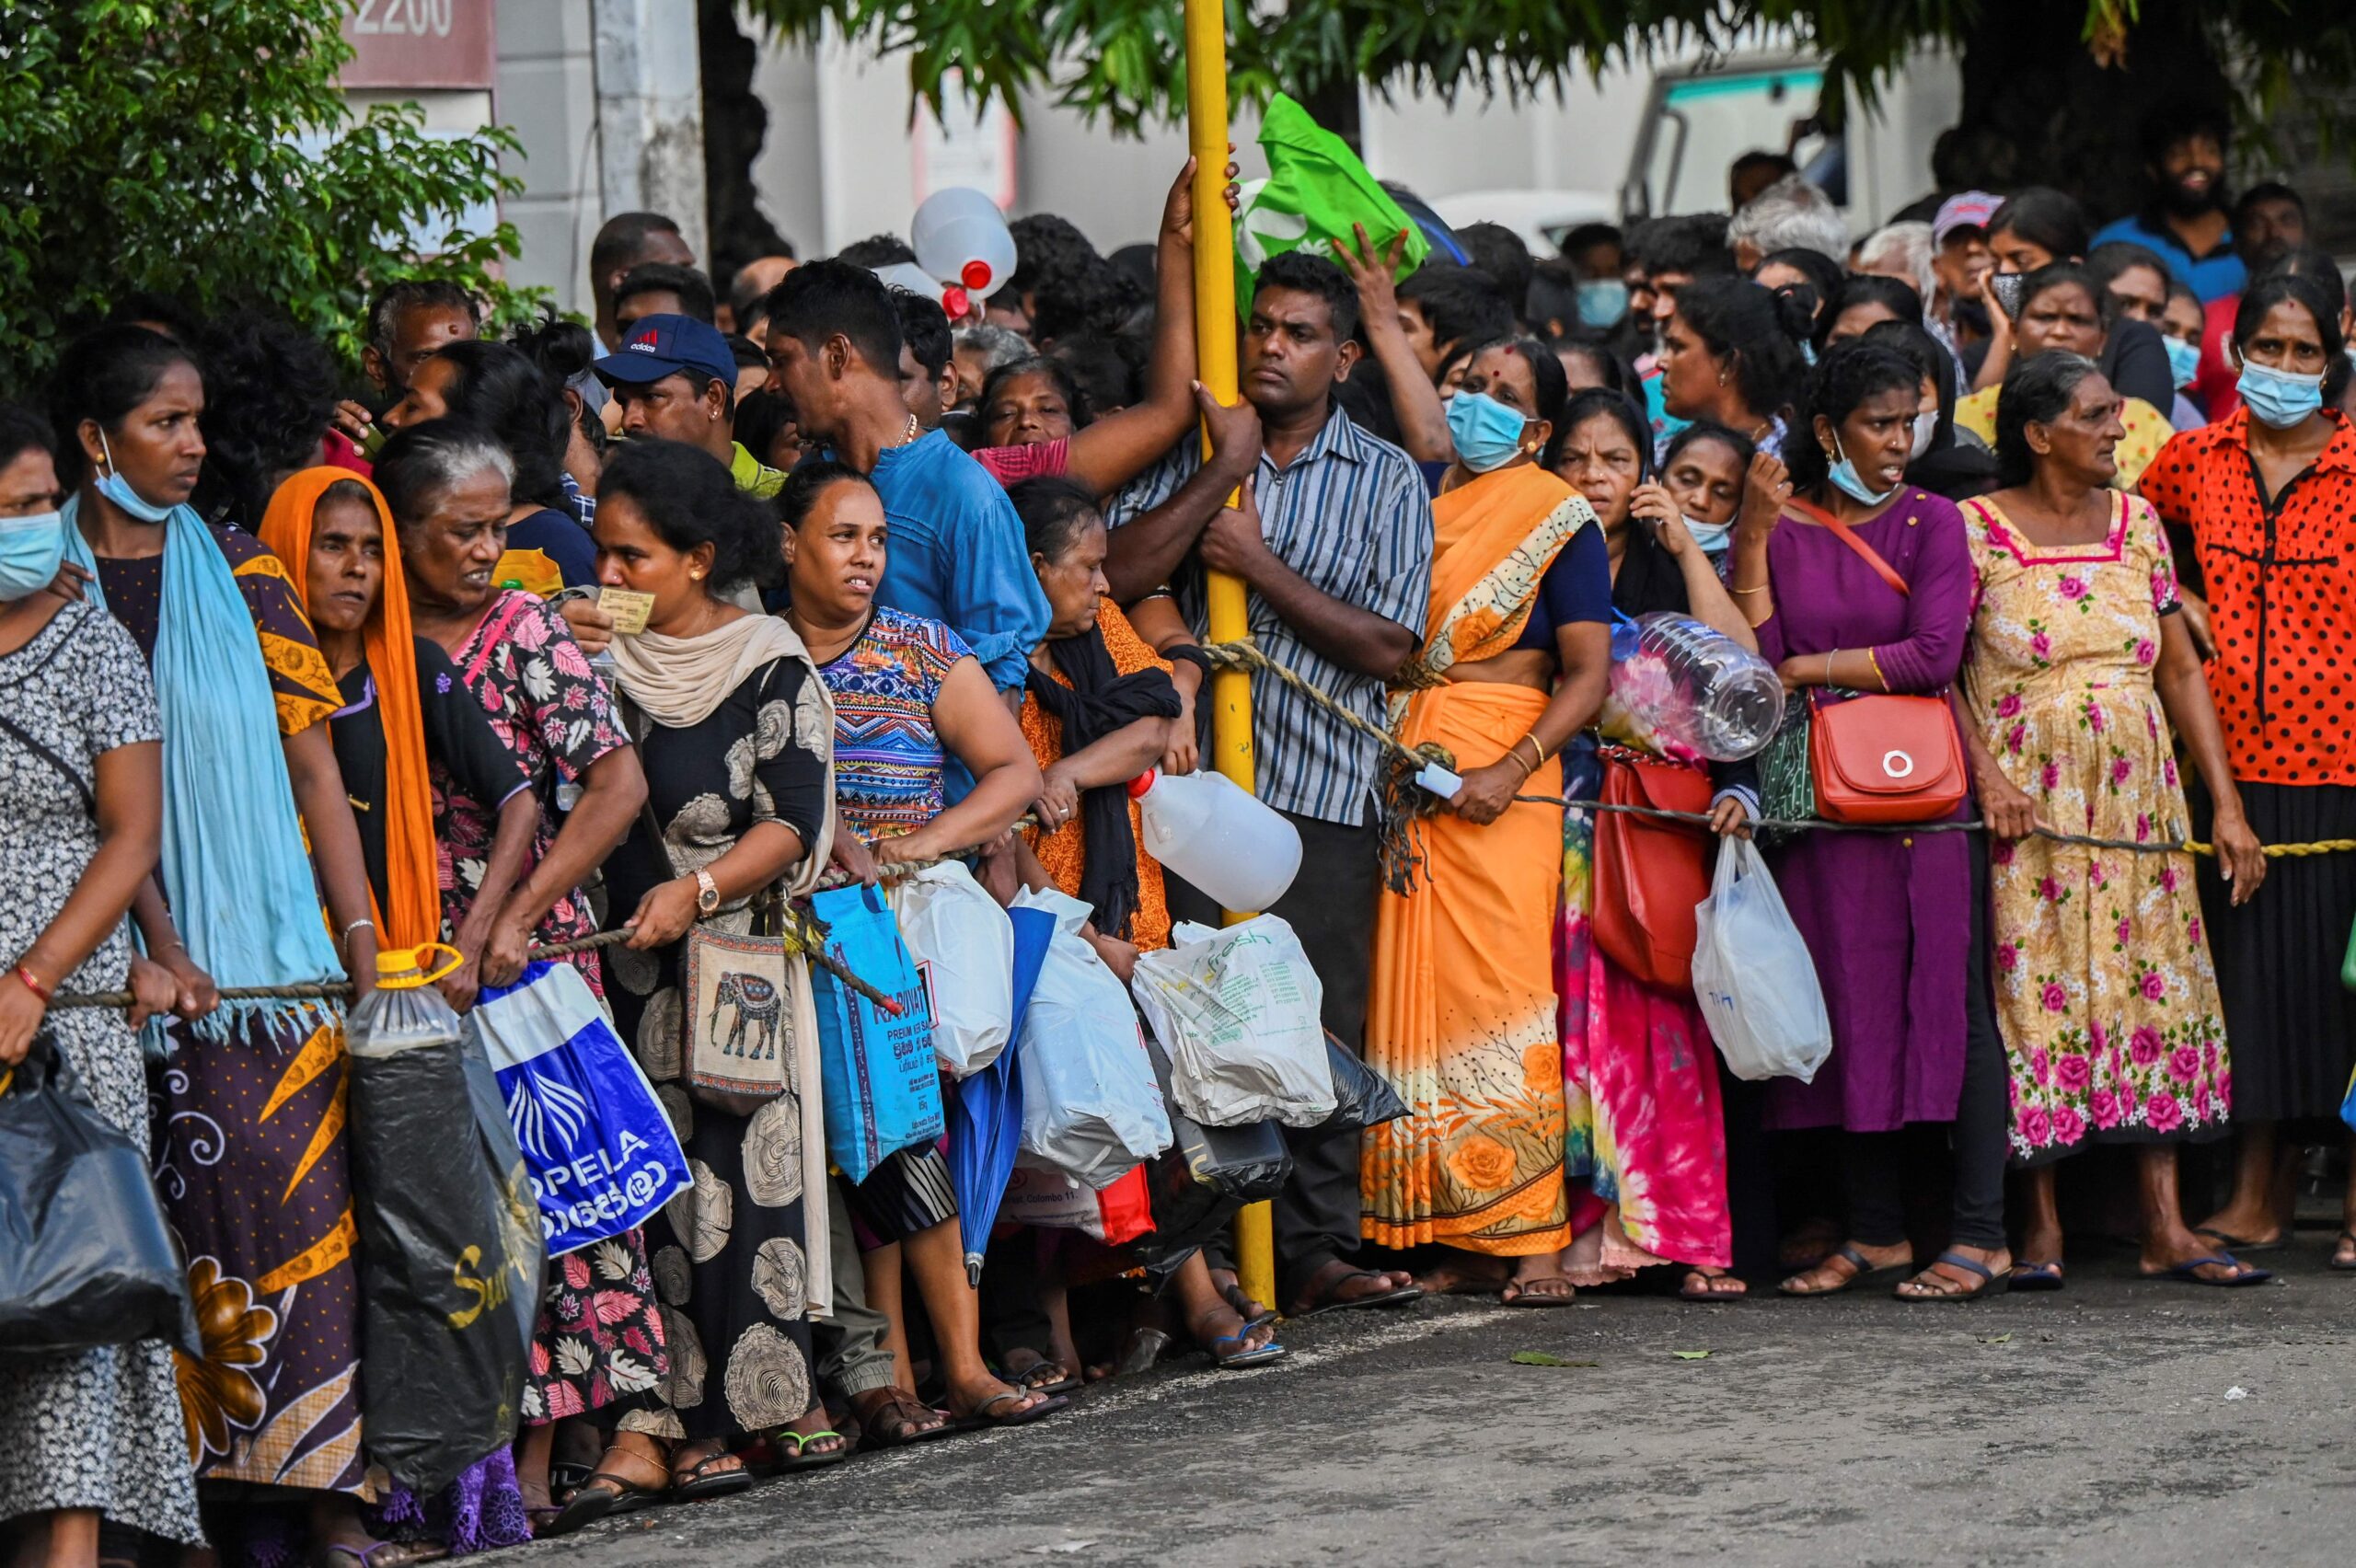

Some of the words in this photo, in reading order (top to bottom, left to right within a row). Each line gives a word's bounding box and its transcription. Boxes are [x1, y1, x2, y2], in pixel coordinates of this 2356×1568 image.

[630, 343, 656, 353] adidas
[1207, 928, 1271, 974] fresh
[1026, 1193, 1063, 1204] Colombo
